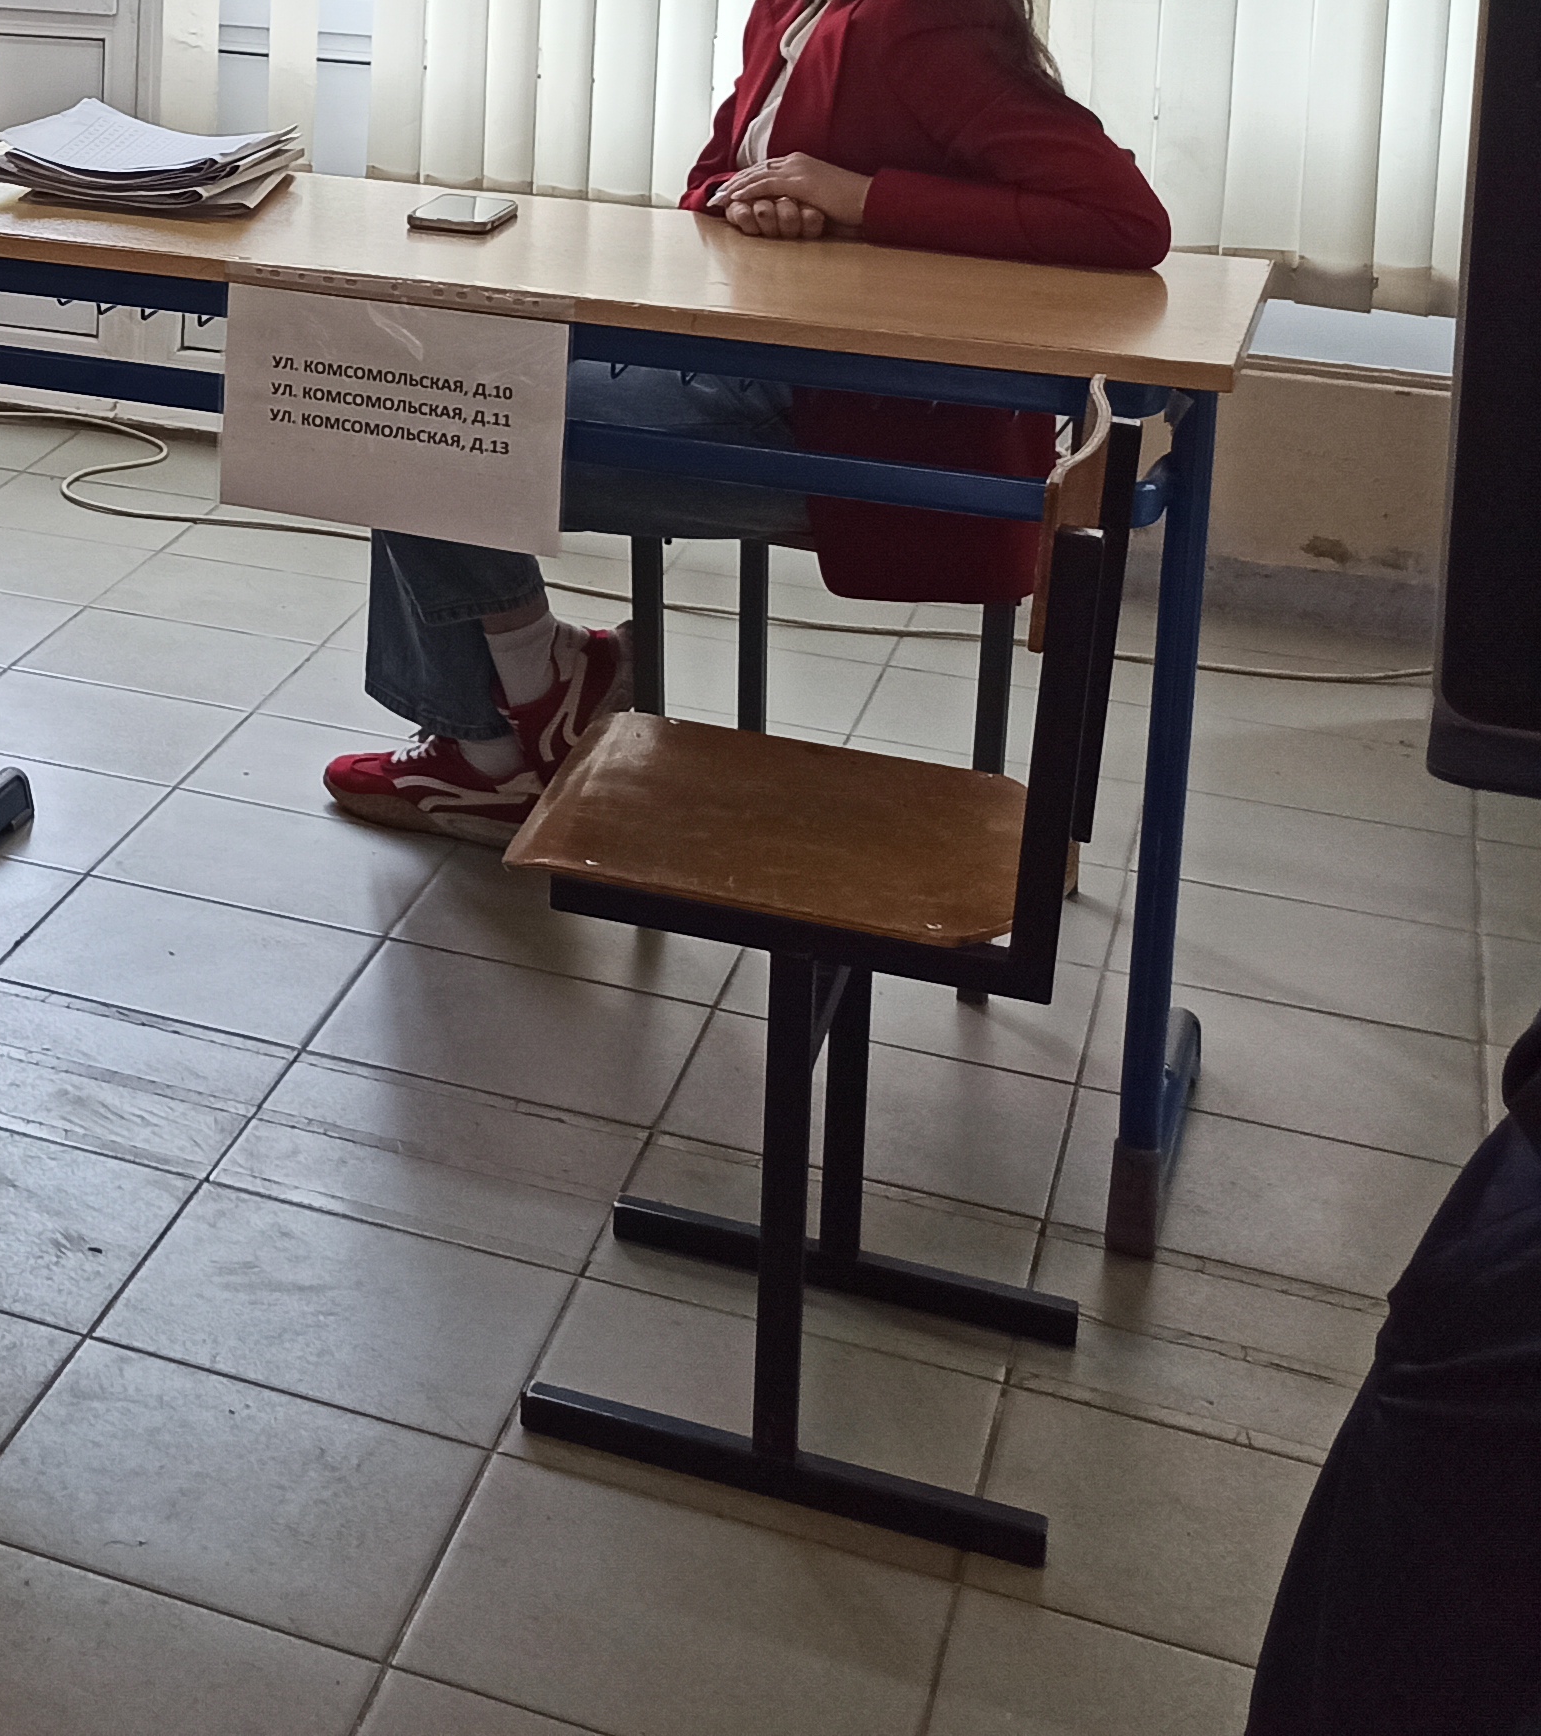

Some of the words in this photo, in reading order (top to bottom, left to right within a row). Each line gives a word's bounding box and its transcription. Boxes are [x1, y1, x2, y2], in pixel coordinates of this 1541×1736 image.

[272, 355, 299, 371] УЛ.
[304, 359, 468, 396] КОМСОМОЛЬСКАЯ,
[473, 382, 513, 400] Д.10
[271, 382, 297, 398] УЛ.
[302, 386, 467, 423] КОМСОМОЛЬСКАЯ,
[472, 409, 511, 428] Д.11
[269, 408, 296, 425] УЛ.
[301, 412, 466, 452] КОМСОМОЛЬСКАЯ,
[470, 437, 510, 455] Д.13
